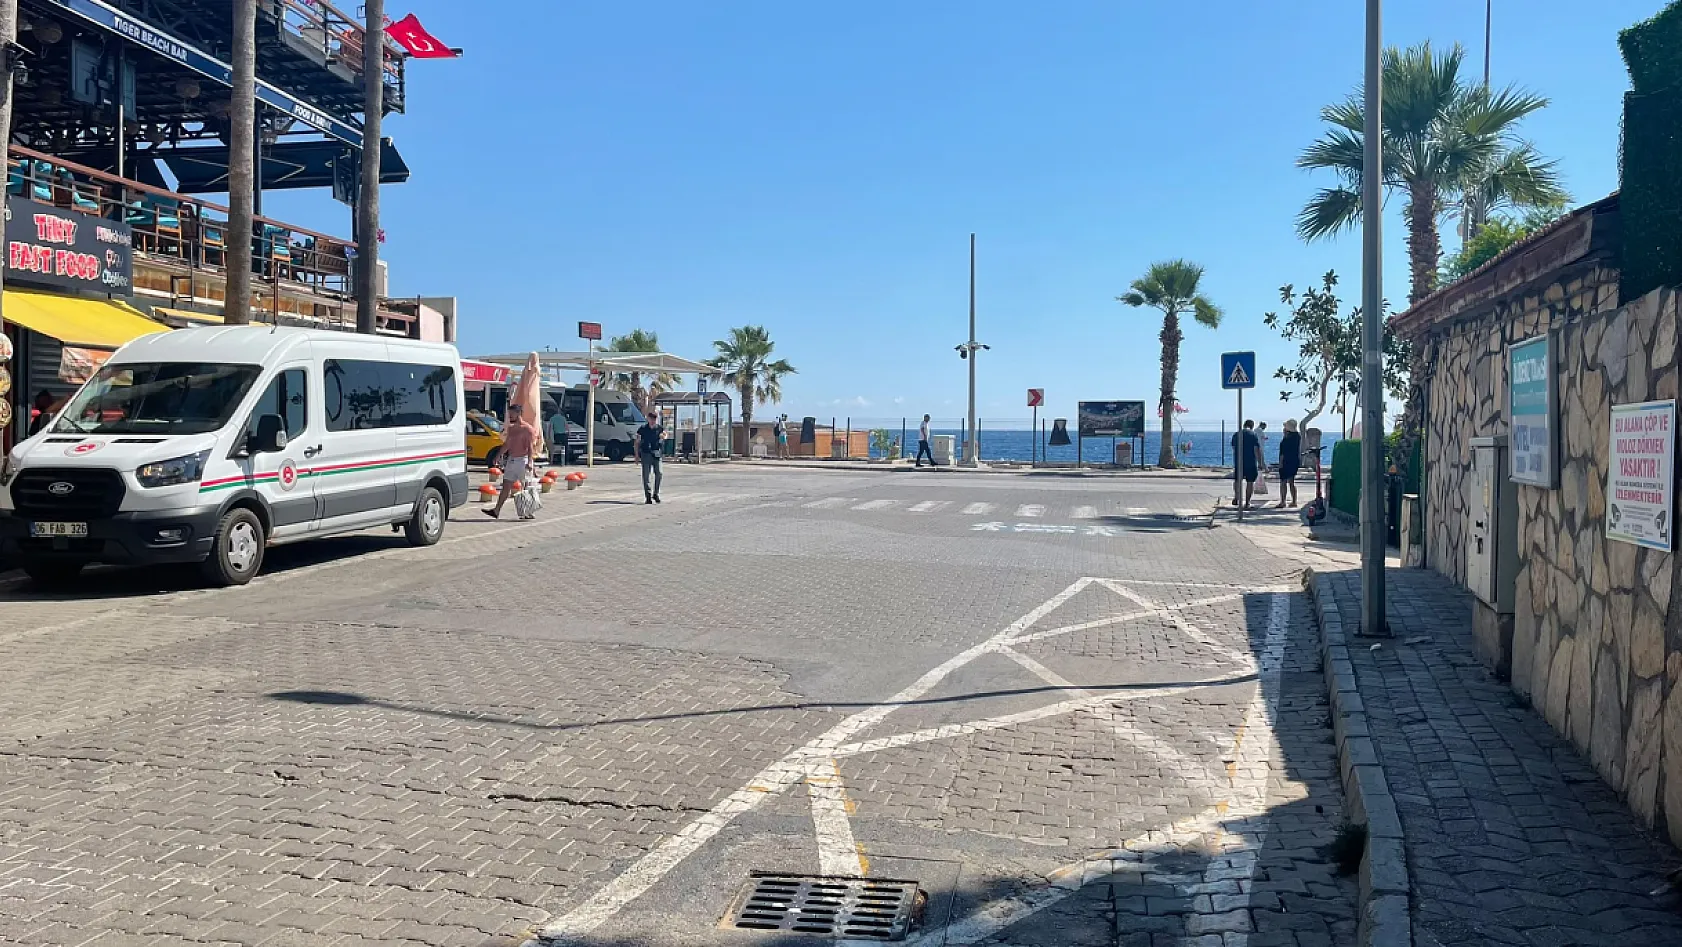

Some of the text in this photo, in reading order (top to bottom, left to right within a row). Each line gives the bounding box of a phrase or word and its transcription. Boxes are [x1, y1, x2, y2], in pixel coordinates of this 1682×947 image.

[114, 16, 188, 61] TIGER BEACH BAR
[294, 104, 311, 120] FOOD
[9, 241, 101, 281] FAST FOOD
[1616, 412, 1669, 435] BU ALANA ÇÖP VE
[1617, 435, 1664, 454] MOLOZ DÖKMEK
[1620, 458, 1656, 478] YASAKTIR
[50, 523, 65, 533] FAB
[71, 523, 87, 534] 326
